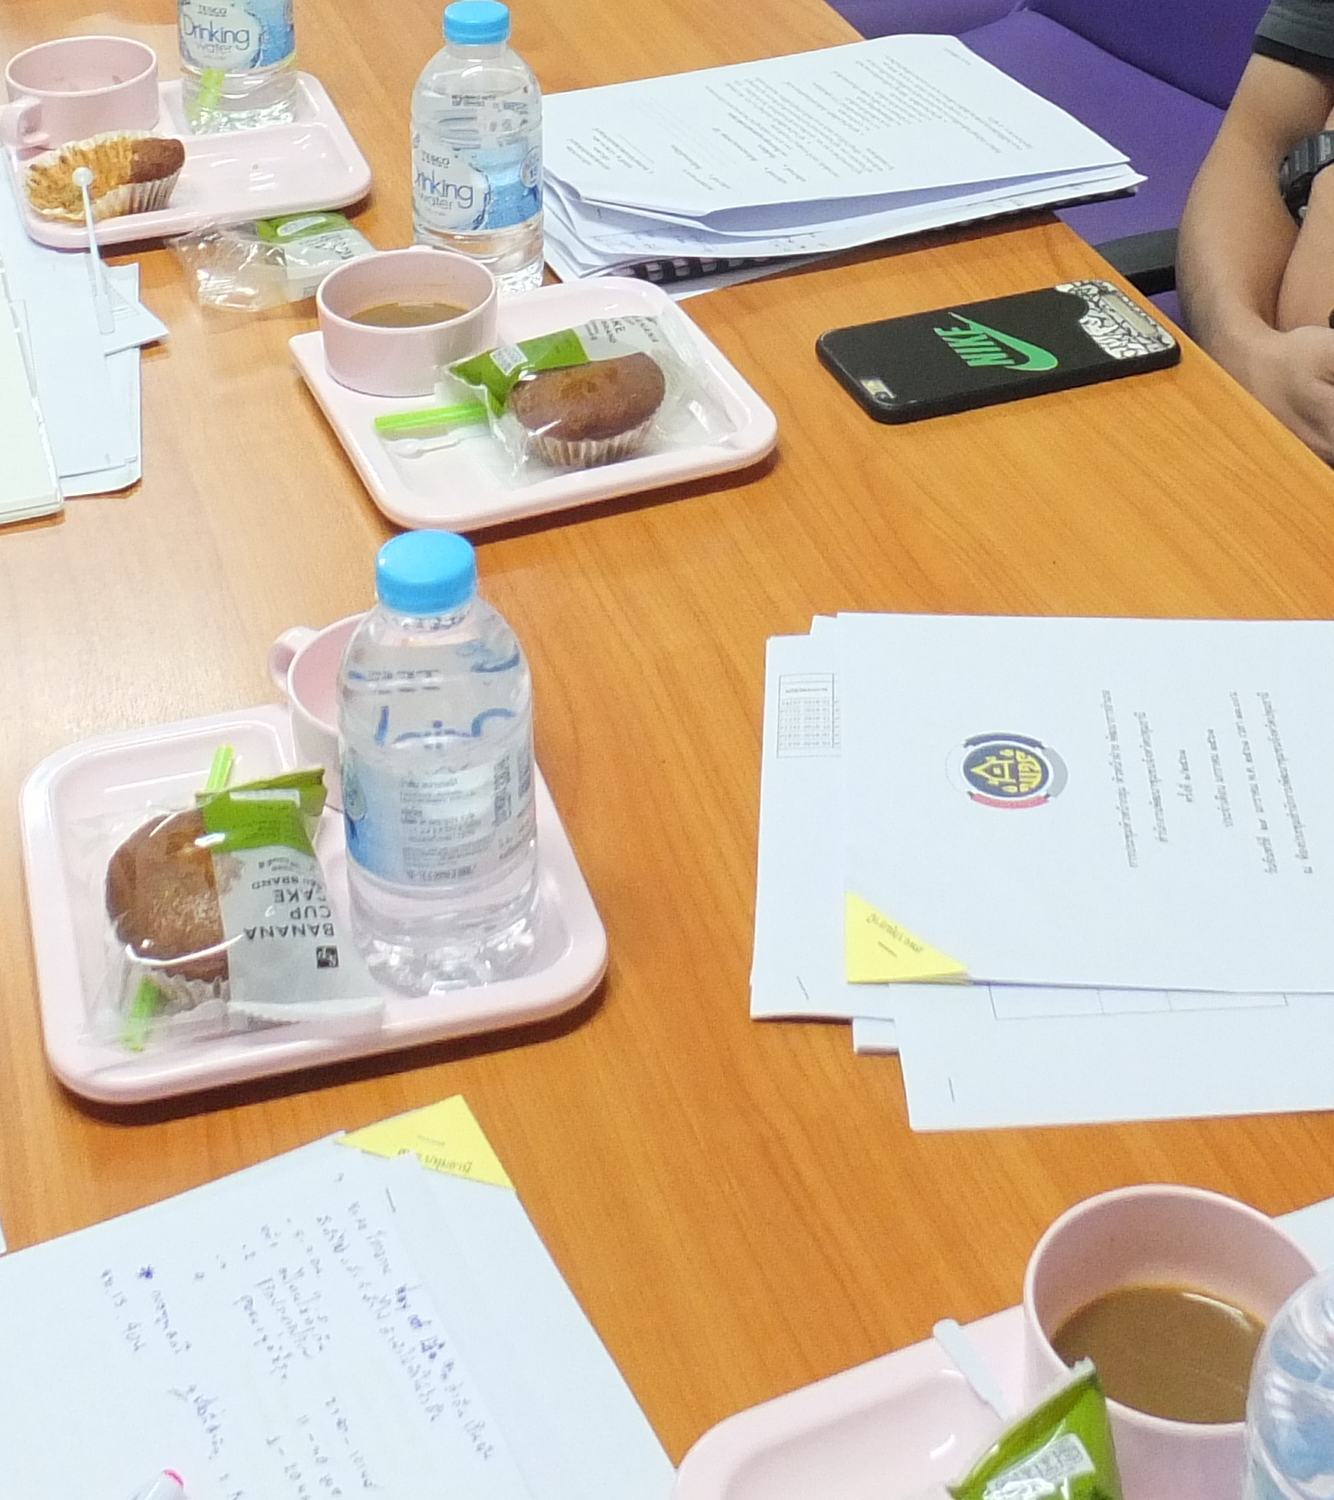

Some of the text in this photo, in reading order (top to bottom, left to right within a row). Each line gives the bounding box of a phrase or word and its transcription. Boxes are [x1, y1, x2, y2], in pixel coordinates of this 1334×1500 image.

[182, 11, 250, 51] Drinking
[415, 168, 474, 209] rinking
[933, 322, 1015, 367] NIKE
[244, 922, 335, 940] BANANA
[290, 905, 331, 920] CUP
